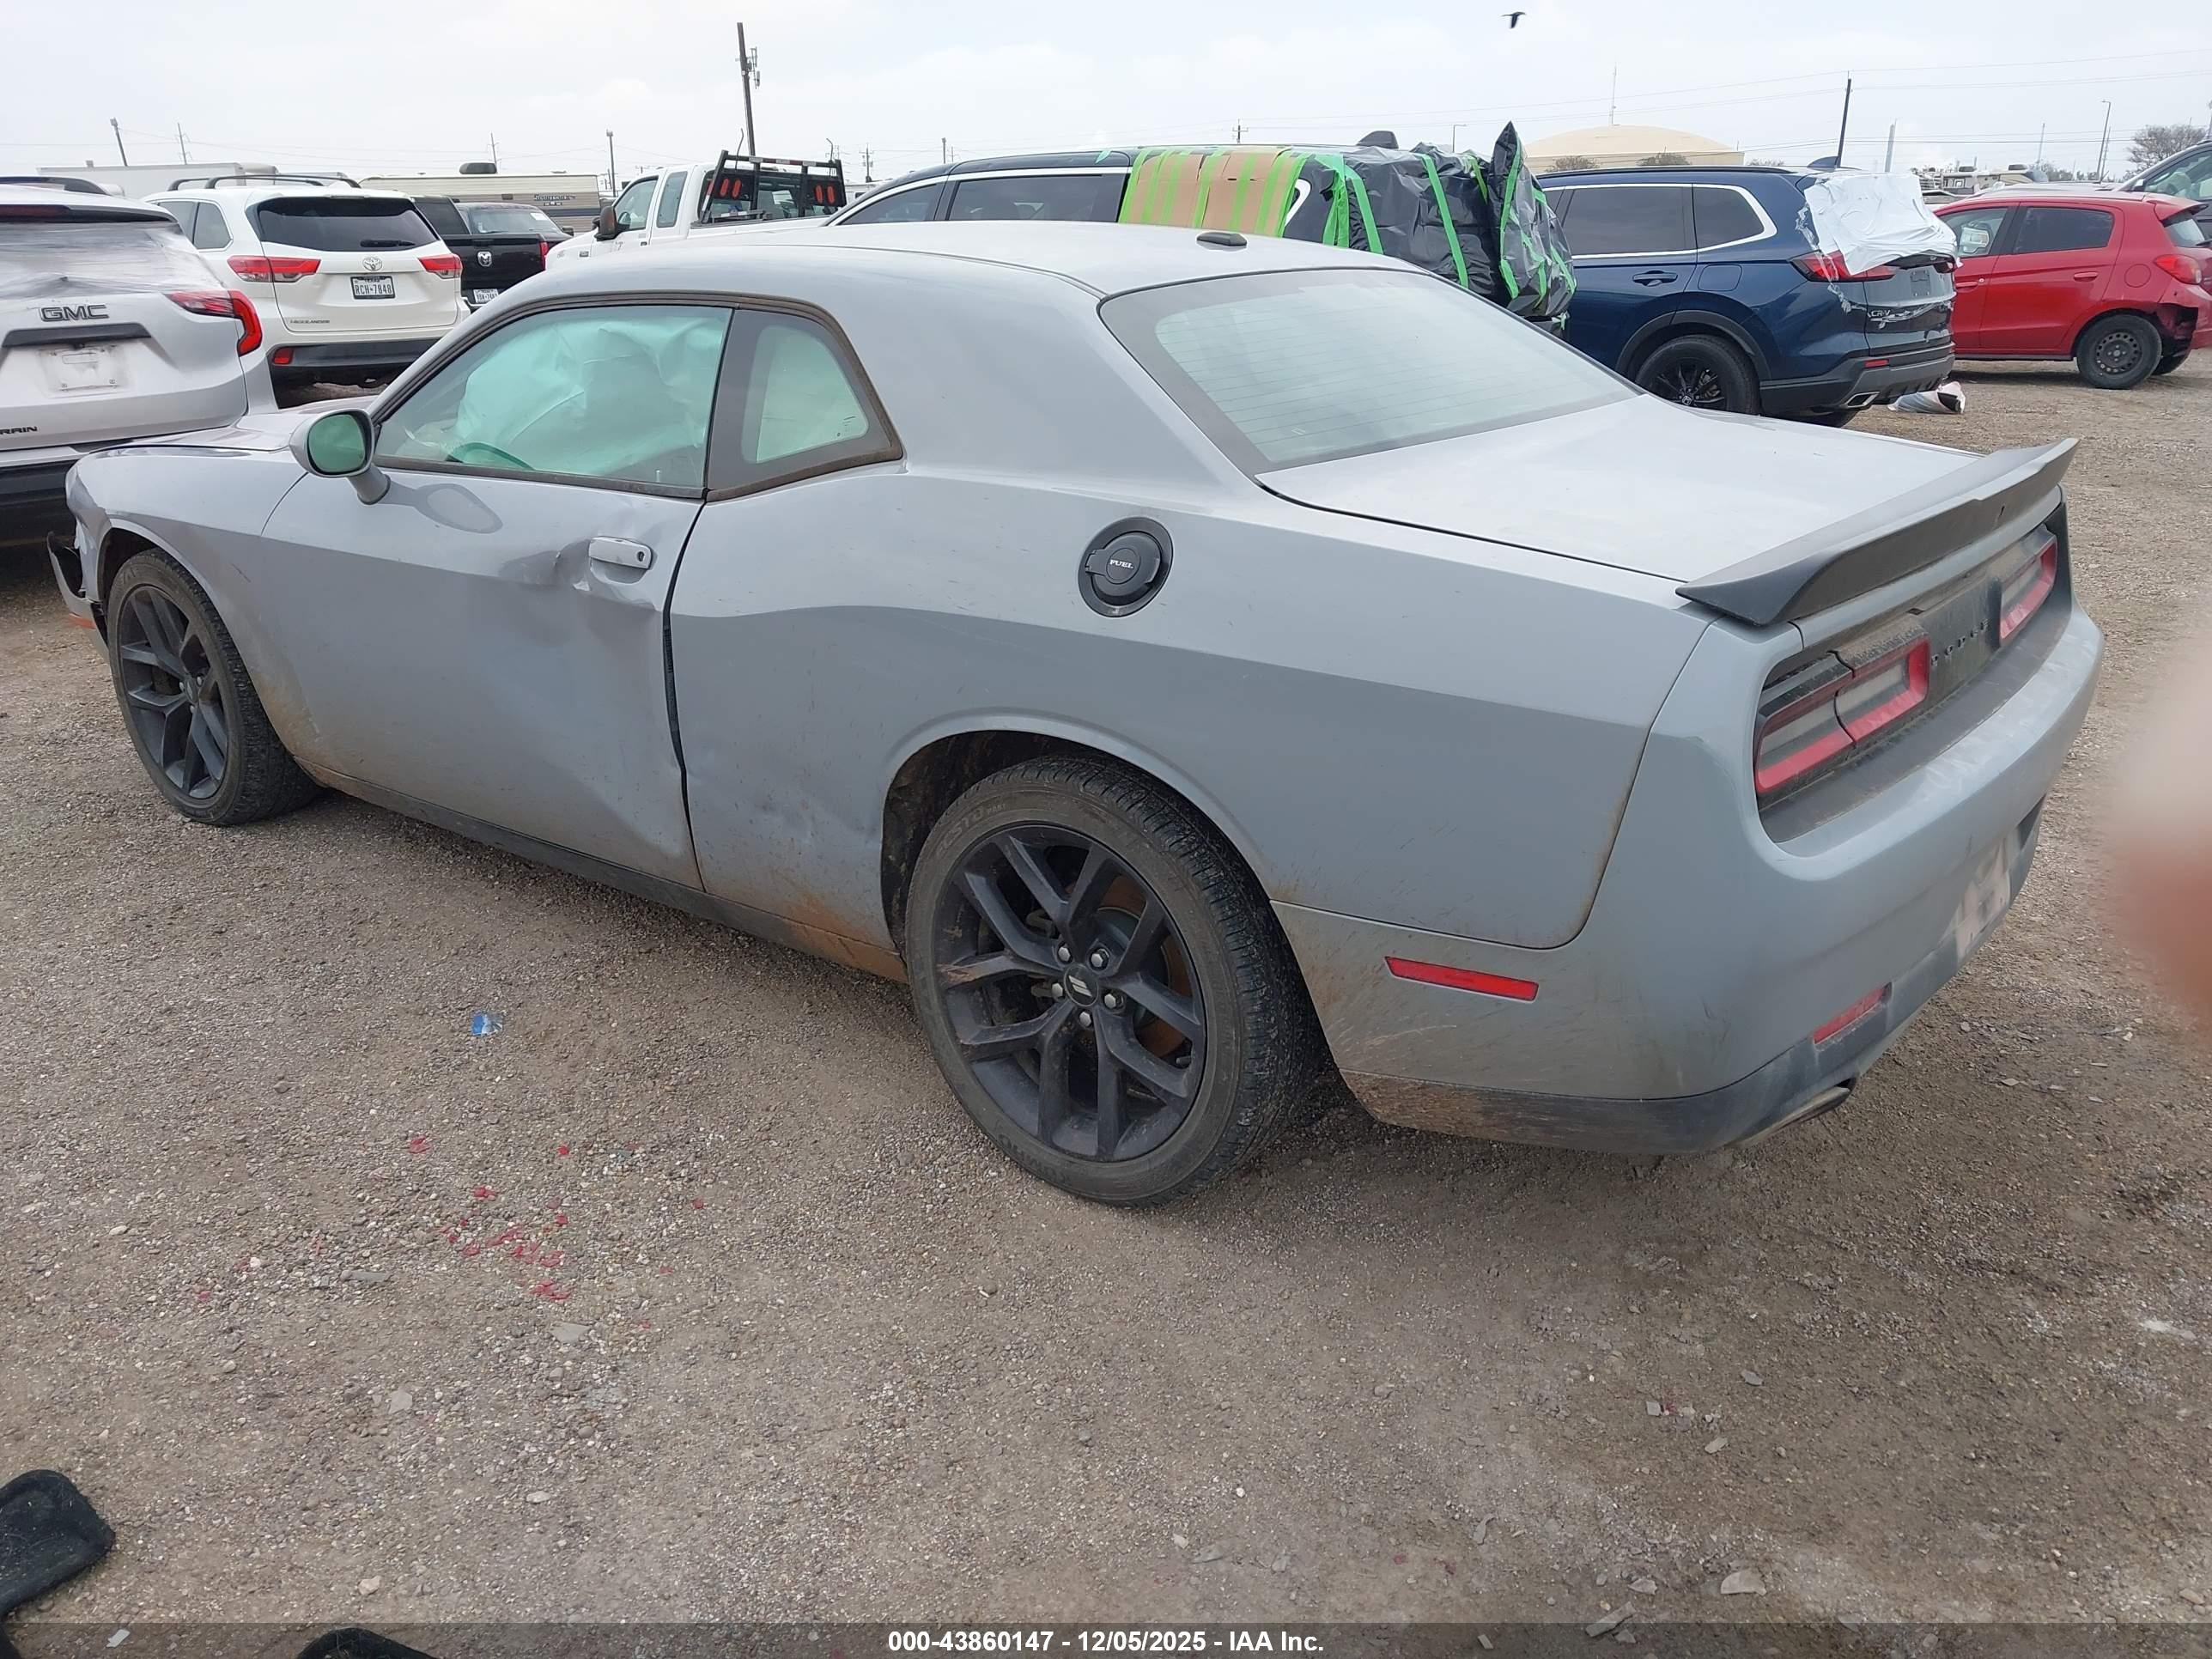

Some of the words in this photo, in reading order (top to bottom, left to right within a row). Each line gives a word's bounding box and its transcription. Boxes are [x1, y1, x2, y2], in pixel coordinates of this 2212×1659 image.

[40, 304, 110, 322] GMC
[1870, 309, 1891, 318] CR-V
[1109, 559, 1134, 569] FUEL
